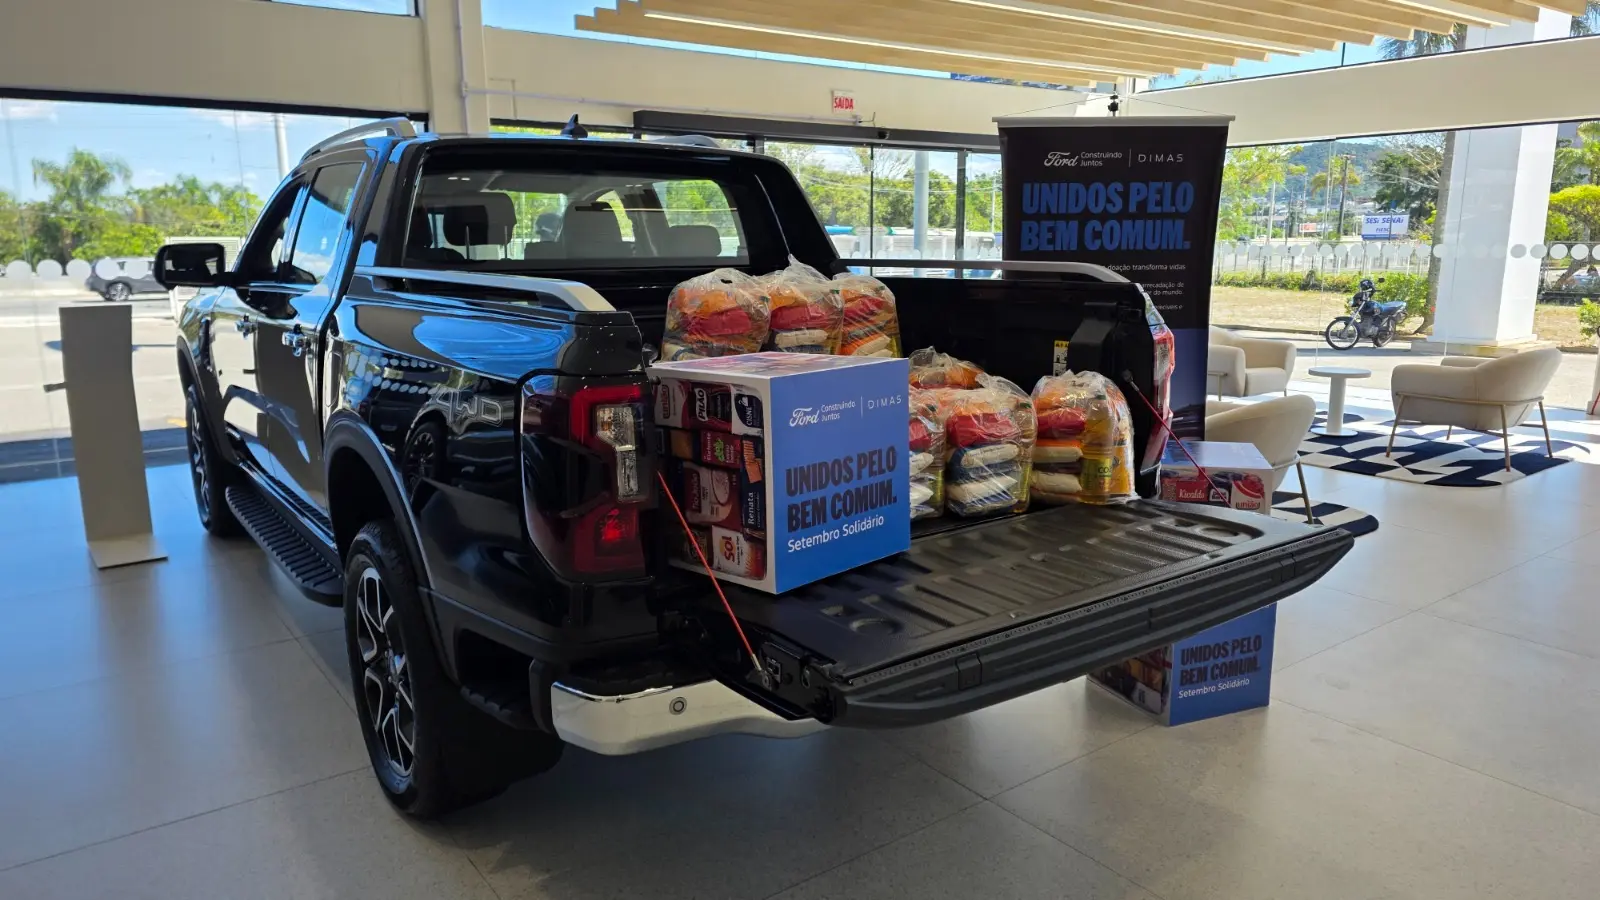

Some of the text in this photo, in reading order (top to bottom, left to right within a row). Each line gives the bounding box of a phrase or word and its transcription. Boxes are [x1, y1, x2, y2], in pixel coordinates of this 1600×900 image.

[1044, 151, 1079, 167] Ford
[1080, 151, 1184, 162] Construindo DIMAS
[1080, 159, 1103, 167] Juntos
[1022, 181, 1195, 214] UNIDOS PELO
[1020, 219, 1191, 252] BEM COMUM.
[1108, 264, 1131, 272] doação
[820, 395, 902, 412] Construindo DIMAS
[745, 406, 753, 426] CISNE
[789, 407, 821, 427] Ford
[821, 412, 841, 422] Juntos
[785, 446, 898, 497] UNIDOS PELO
[747, 491, 755, 525] Renata
[787, 496, 827, 533] BEM
[830, 478, 898, 521] COMUM.
[788, 515, 884, 553] Setembro Solidário
[1180, 634, 1262, 666] UNIDOS PELO
[1179, 656, 1261, 687] BEM COMUM.
[1178, 677, 1250, 699] Setembro Solidário
